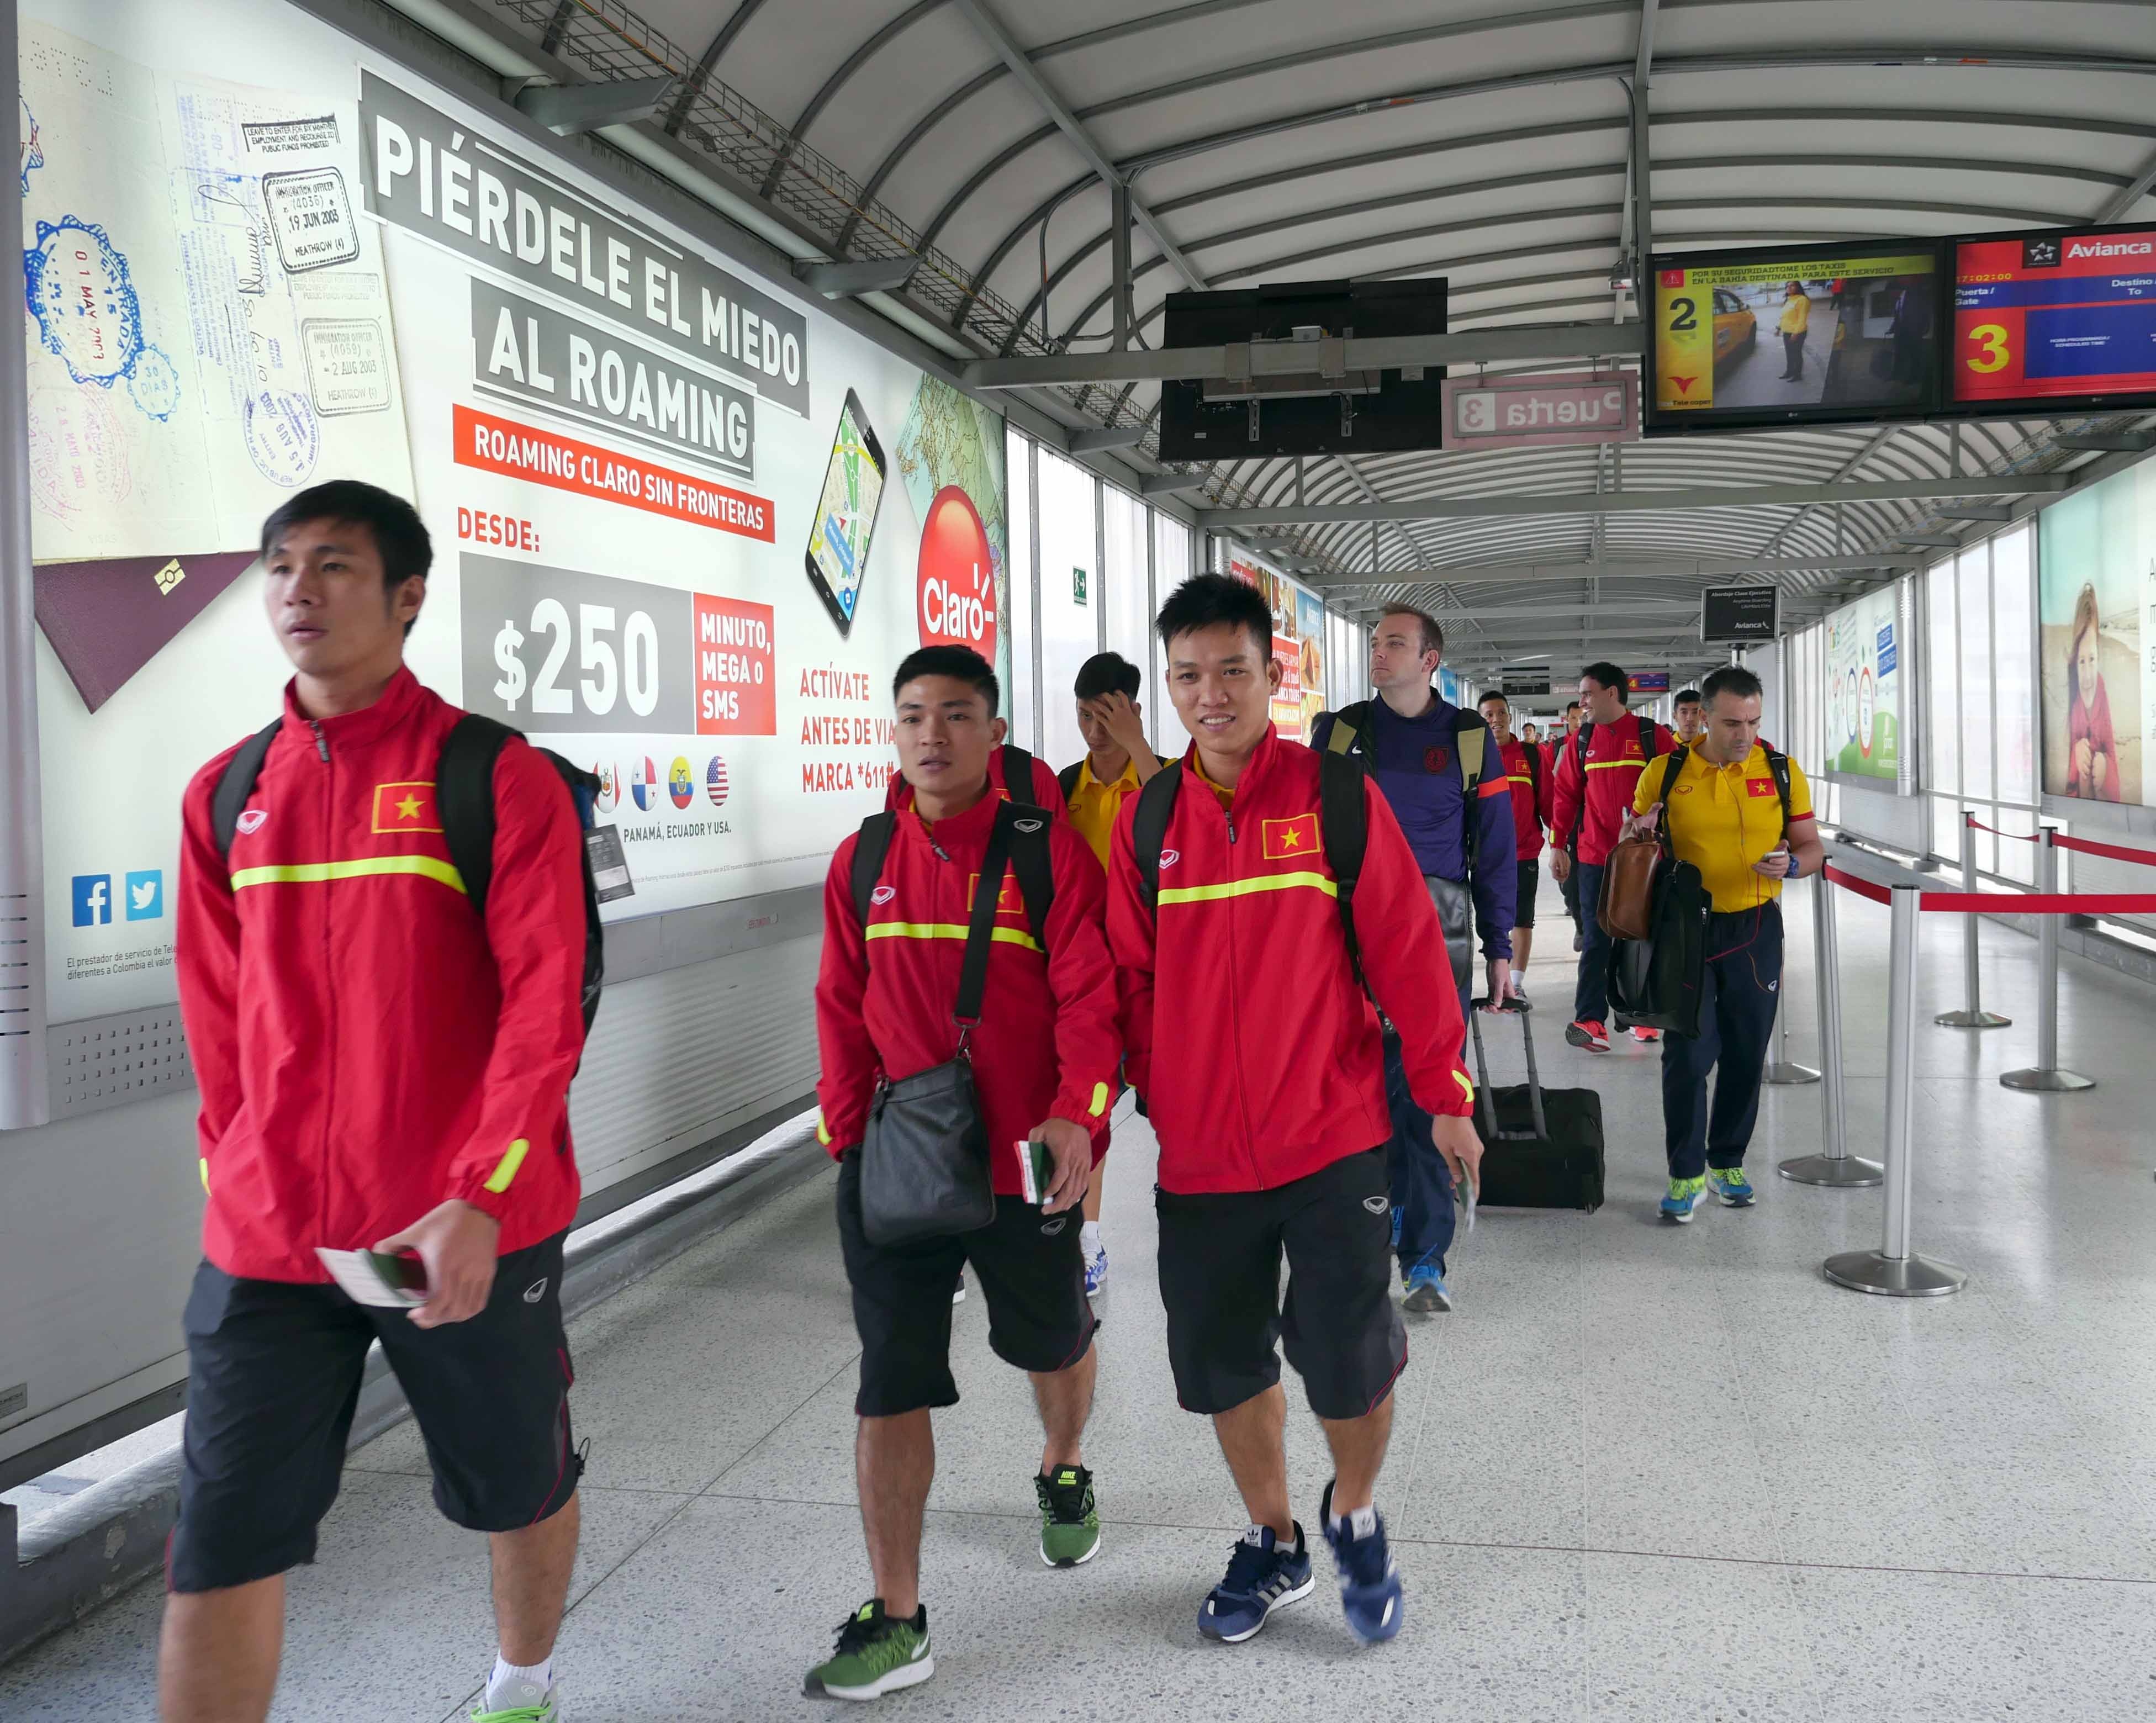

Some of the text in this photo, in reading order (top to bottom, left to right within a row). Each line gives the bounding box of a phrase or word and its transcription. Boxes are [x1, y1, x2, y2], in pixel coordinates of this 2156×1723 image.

[252, 134, 287, 145] EMPLOYMENT
[288, 133, 299, 142] AND
[274, 125, 292, 134] ENTER
[262, 143, 281, 153] PUBLIC
[282, 142, 299, 152] FUNDS
[313, 181, 335, 193] OFFICER
[303, 212, 321, 229] JUN
[321, 209, 340, 225] 2003
[294, 240, 332, 257] HEATHROW
[377, 115, 632, 310] PIÉRDELE
[646, 256, 691, 337] EL
[701, 287, 801, 386] MIEDO
[2068, 241, 2152, 258] Avianca
[1692, 270, 1709, 278] POR
[1705, 276, 1718, 284] LA
[1749, 272, 1800, 282] DESTINADA
[1829, 268, 1852, 277] ESTE
[1852, 266, 1895, 276] SERVICIO
[2111, 278, 2153, 287] Destino
[81, 286, 98, 319] MAY
[1955, 288, 1989, 297] Puerta
[2127, 287, 2142, 295] To
[100, 257, 134, 350] ENTRADA
[1669, 297, 1697, 332] 2
[1967, 324, 2010, 373] 3
[341, 361, 358, 375] AUG
[489, 306, 748, 459] AL ROAMING
[327, 388, 366, 401] HEATHROW
[276, 423, 293, 447] AUG
[475, 424, 764, 531] ROAMING CLARO SIN FRONTERAS
[458, 506, 540, 552] DESDE:
[923, 576, 984, 641] Claro
[701, 612, 771, 656] MINUTO,
[494, 598, 660, 717] $250
[702, 651, 751, 684] MEGA
[800, 661, 869, 701] ACTÍVATE
[1629, 678, 1636, 688] 4
[702, 689, 739, 720] SMS
[801, 716, 850, 745] ANTES
[854, 717, 871, 745] DE
[802, 762, 854, 793] MARCA
[623, 821, 732, 843] PANAMÁ, ECUADOR Y USA.
[67, 958, 76, 968] El
[77, 952, 113, 968] prestador
[114, 953, 123, 961] de
[125, 948, 152, 960] servicio
[154, 946, 162, 955] de
[67, 968, 105, 980] diferentes
[113, 961, 146, 974] Colombia
[147, 959, 154, 968] el
[156, 956, 173, 966] valor
[1060, 1471, 1076, 1479] NIKE
